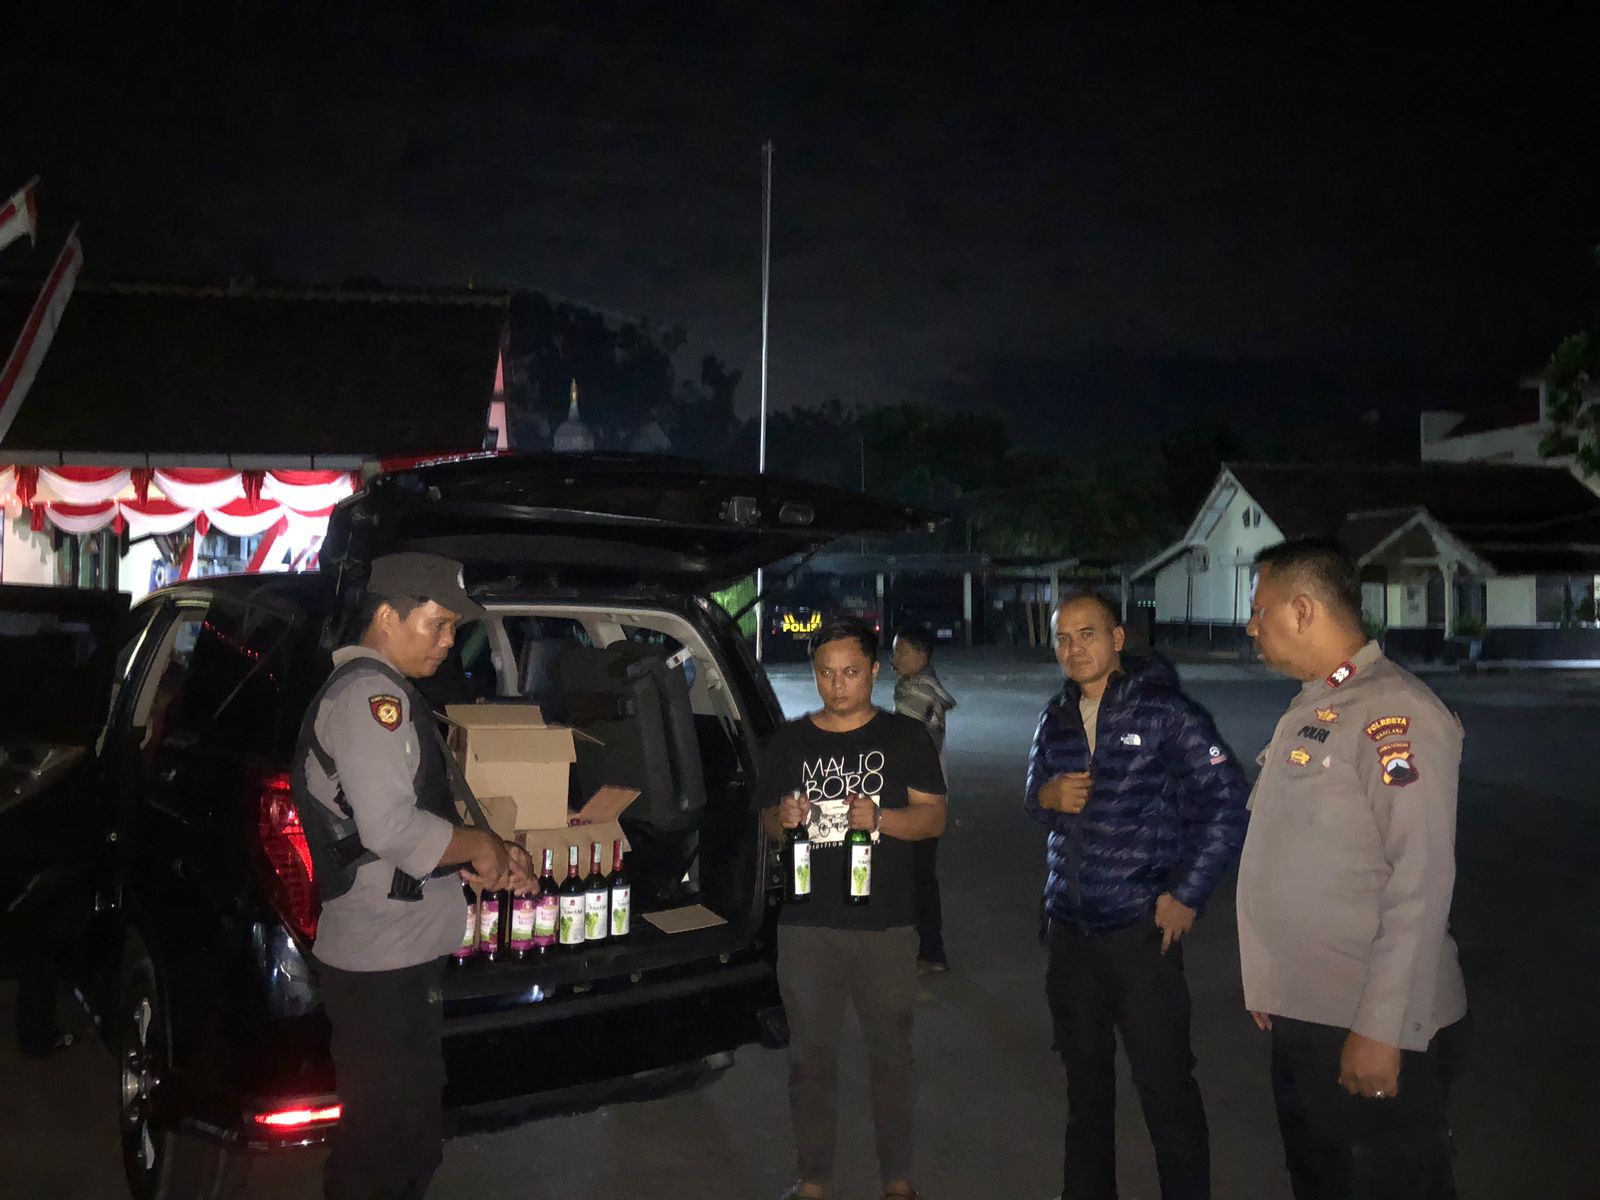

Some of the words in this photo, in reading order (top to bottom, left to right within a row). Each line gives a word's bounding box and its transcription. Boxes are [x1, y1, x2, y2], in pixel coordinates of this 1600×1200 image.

[1298, 725, 1331, 744] POLRI
[1366, 717, 1407, 735] POLRESTA
[802, 750, 884, 783] MALIO
[805, 770, 884, 803] BORO
